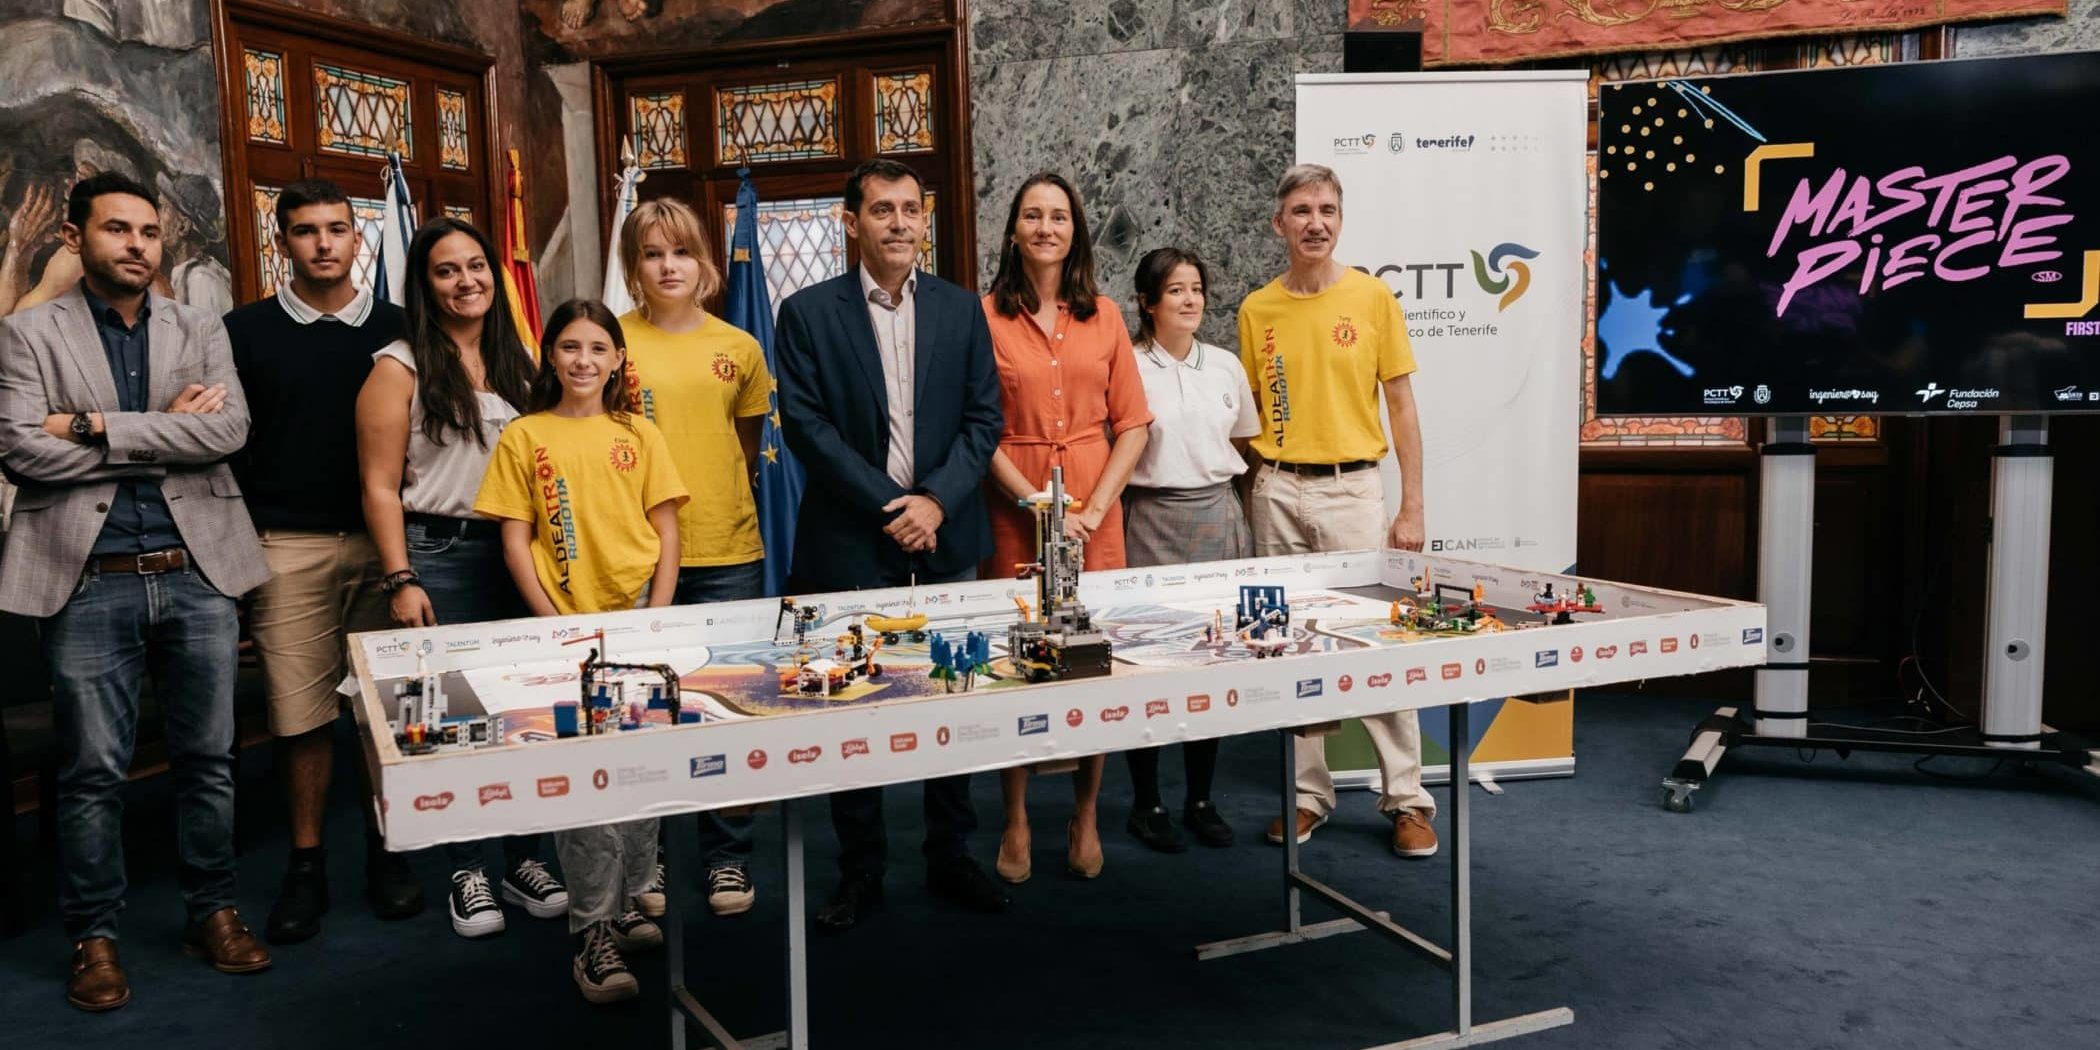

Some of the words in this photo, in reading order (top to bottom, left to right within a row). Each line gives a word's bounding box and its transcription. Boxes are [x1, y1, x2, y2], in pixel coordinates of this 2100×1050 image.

[1334, 138, 1360, 147] PCTT
[1766, 154, 2071, 258] MASTER
[1352, 263, 1464, 299] CTT
[1404, 309, 1456, 321] ientífico
[1458, 310, 1466, 322] y
[1408, 328, 1424, 338] co
[1428, 325, 1443, 338] de
[1448, 323, 1498, 337] Tenerife
[1704, 389, 1728, 397] PCTT
[1949, 389, 1999, 399] Fundación
[1947, 400, 1977, 410] Cepsa
